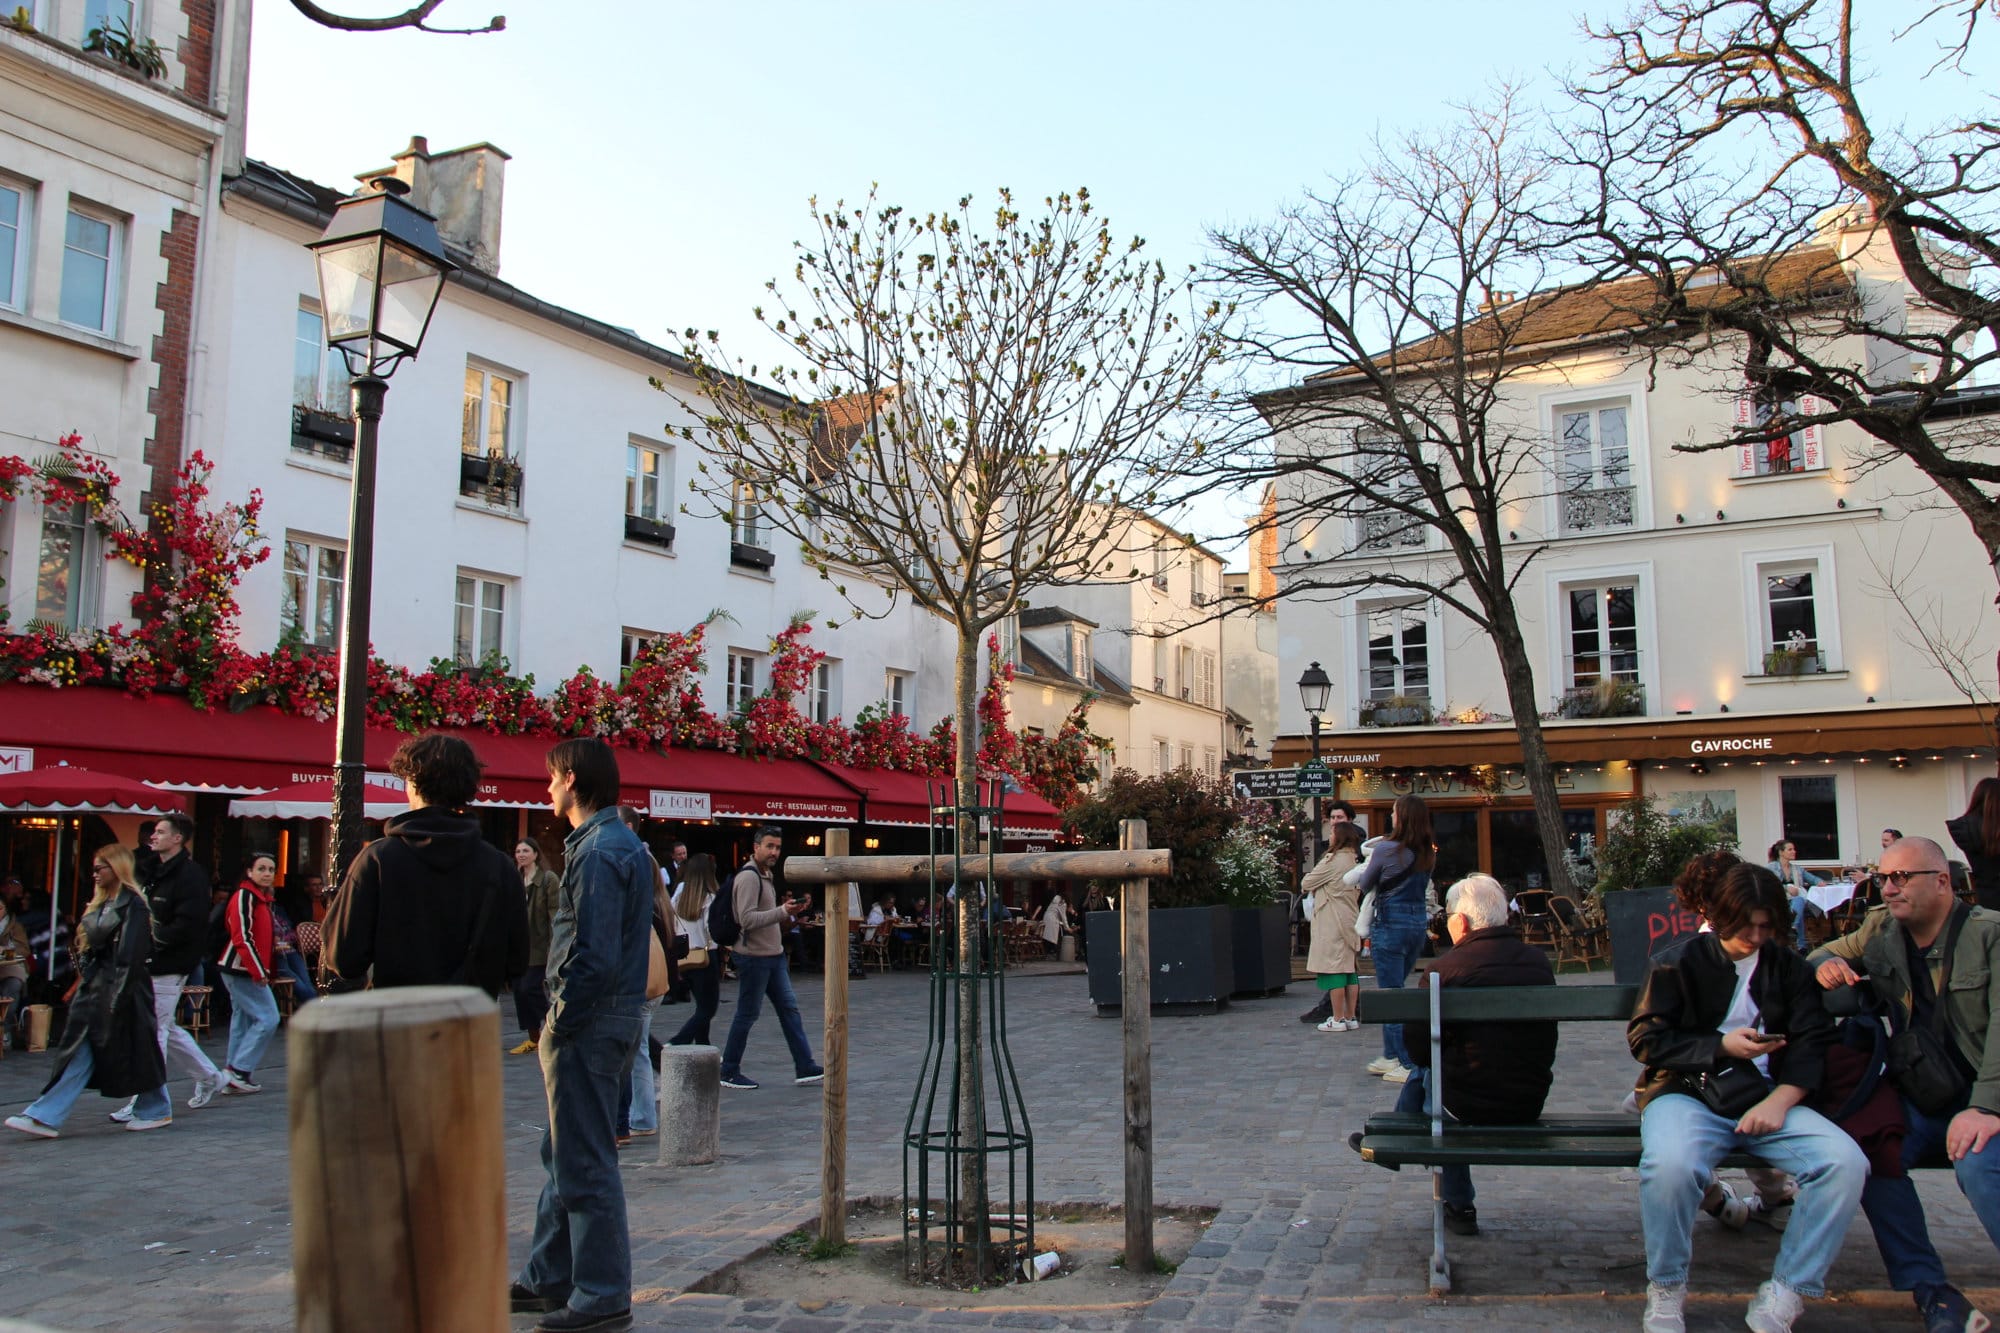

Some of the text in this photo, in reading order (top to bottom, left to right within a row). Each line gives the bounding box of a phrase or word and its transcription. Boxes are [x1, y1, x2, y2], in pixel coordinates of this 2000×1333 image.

[1690, 738, 1773, 754] GAVROCHE
[1320, 754, 1381, 764] RESTAURANT
[292, 773, 335, 783] BUVETT
[788, 803, 828, 811] RESTAURANT
